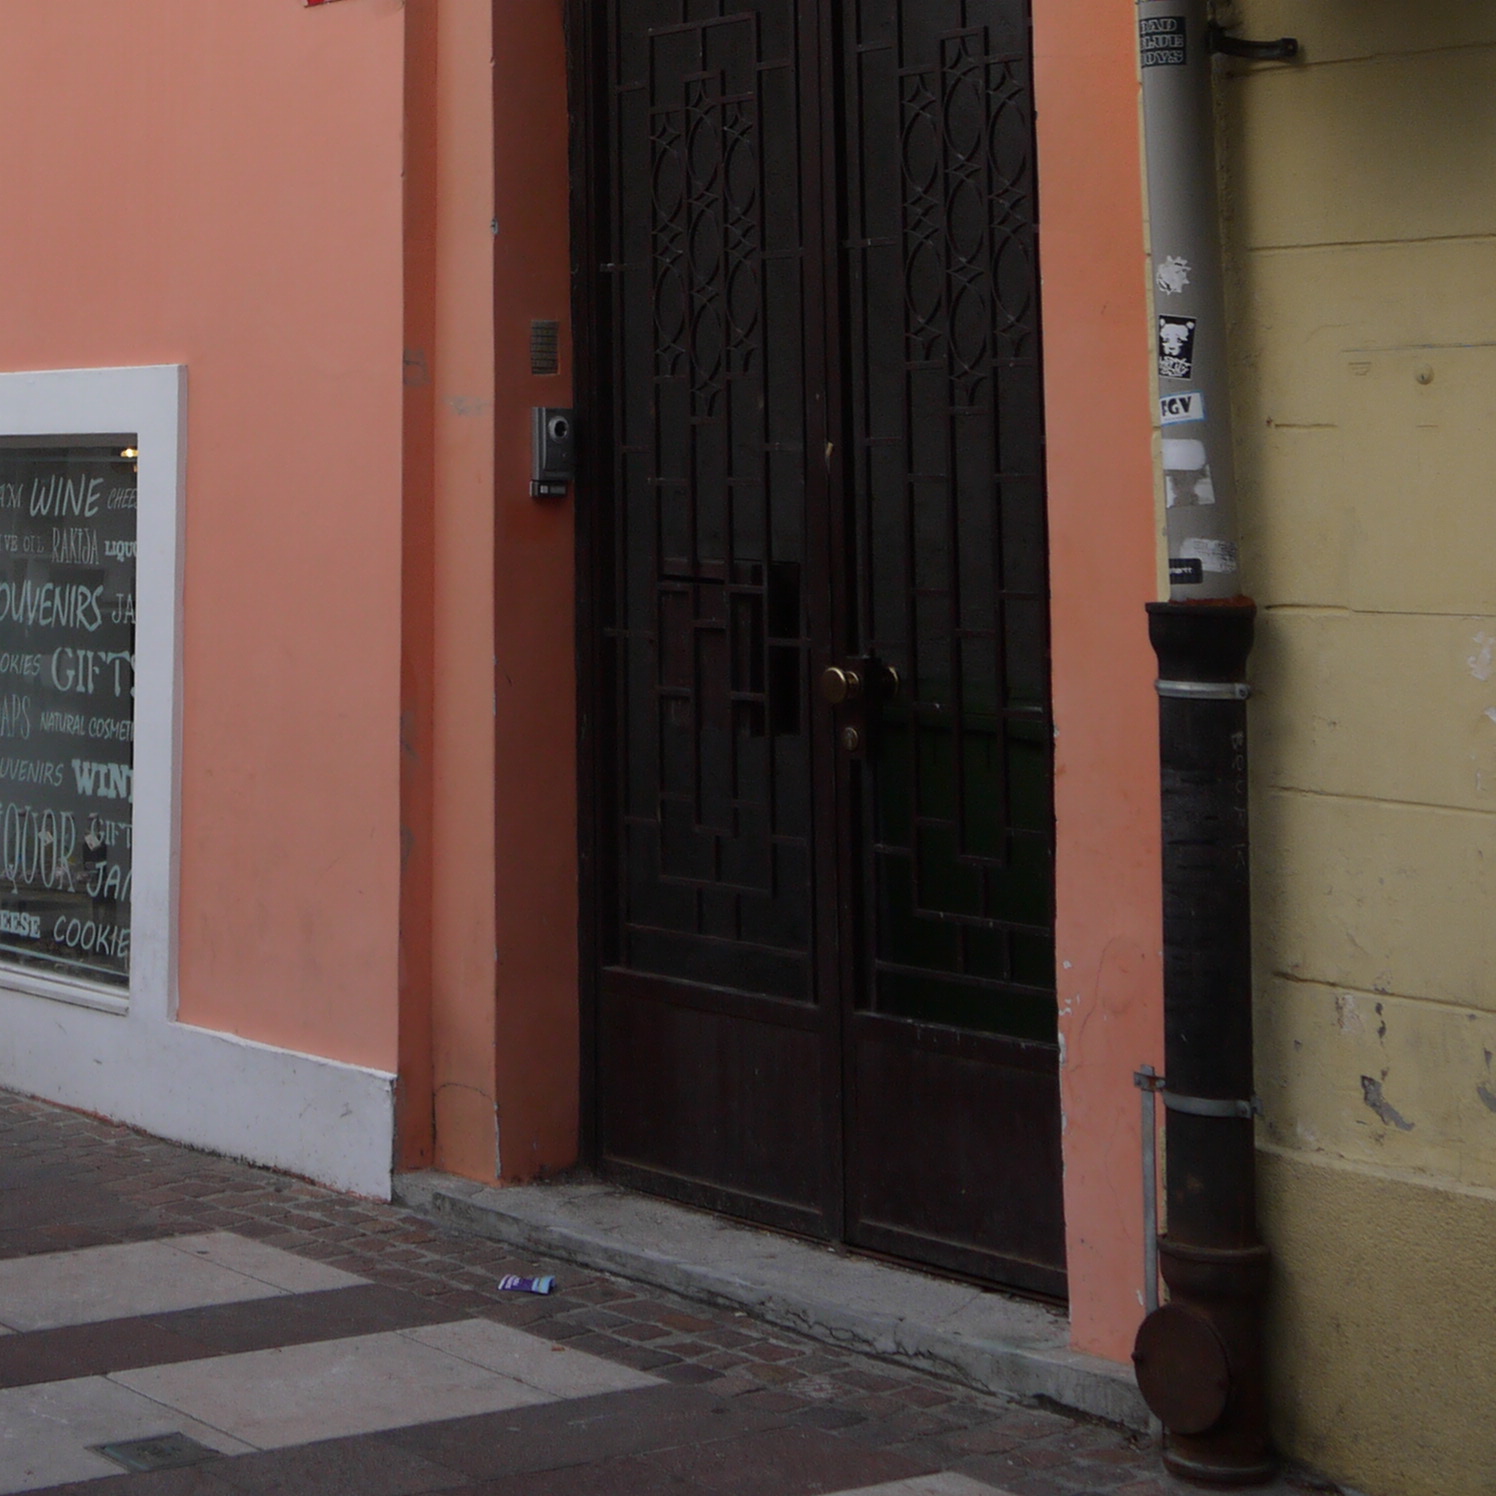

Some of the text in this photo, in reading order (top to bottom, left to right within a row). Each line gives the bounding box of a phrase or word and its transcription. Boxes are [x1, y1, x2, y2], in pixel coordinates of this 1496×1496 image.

[29, 473, 105, 518] WINE
[107, 487, 137, 510] CHEE
[23, 534, 45, 554] OIL
[40, 710, 86, 736] NATURAL
